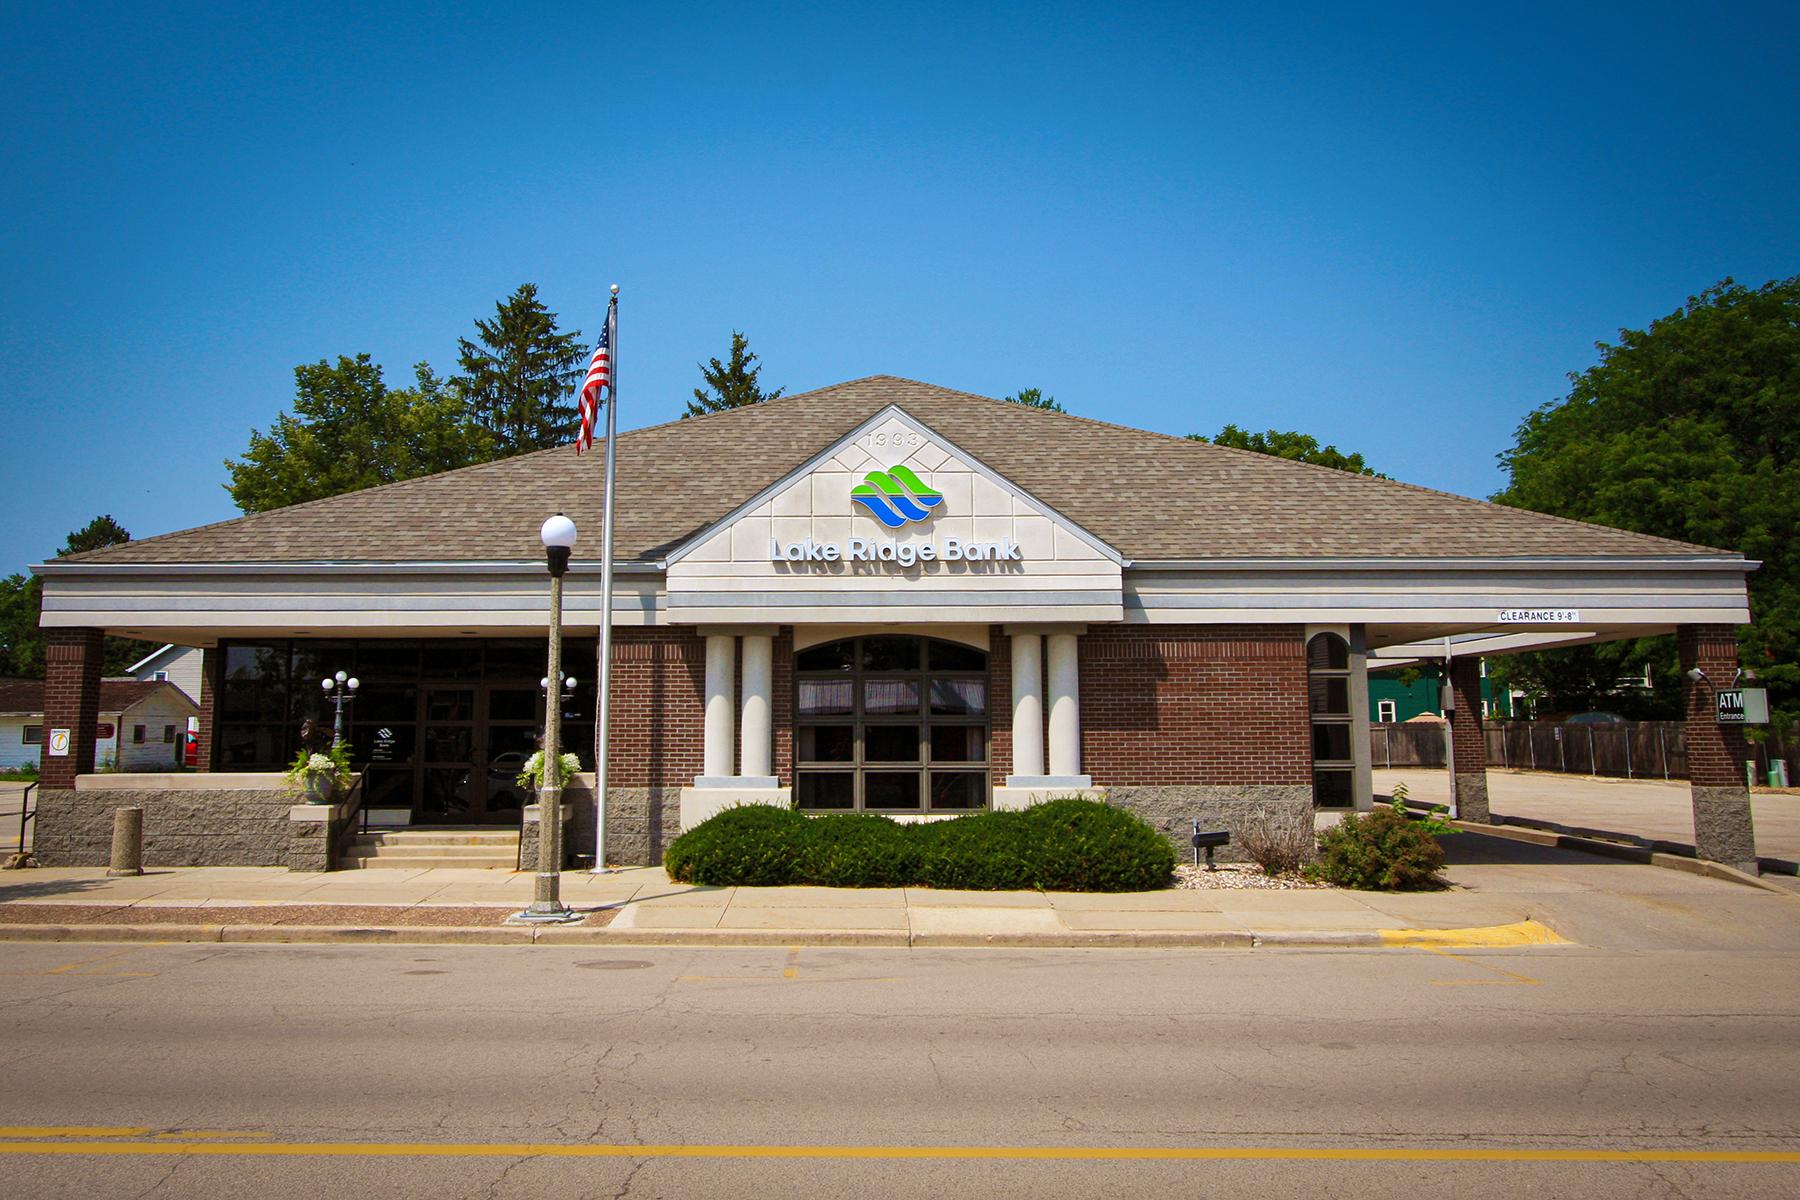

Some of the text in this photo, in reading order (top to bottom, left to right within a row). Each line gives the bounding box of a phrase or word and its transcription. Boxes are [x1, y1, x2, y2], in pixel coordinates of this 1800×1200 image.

[867, 432, 919, 447] 1993
[770, 537, 1022, 567] Lake Ridge Bank
[1500, 612, 1554, 620] CLEARANCE
[1719, 692, 1744, 708] ATM
[1720, 712, 1744, 720] Entrance
